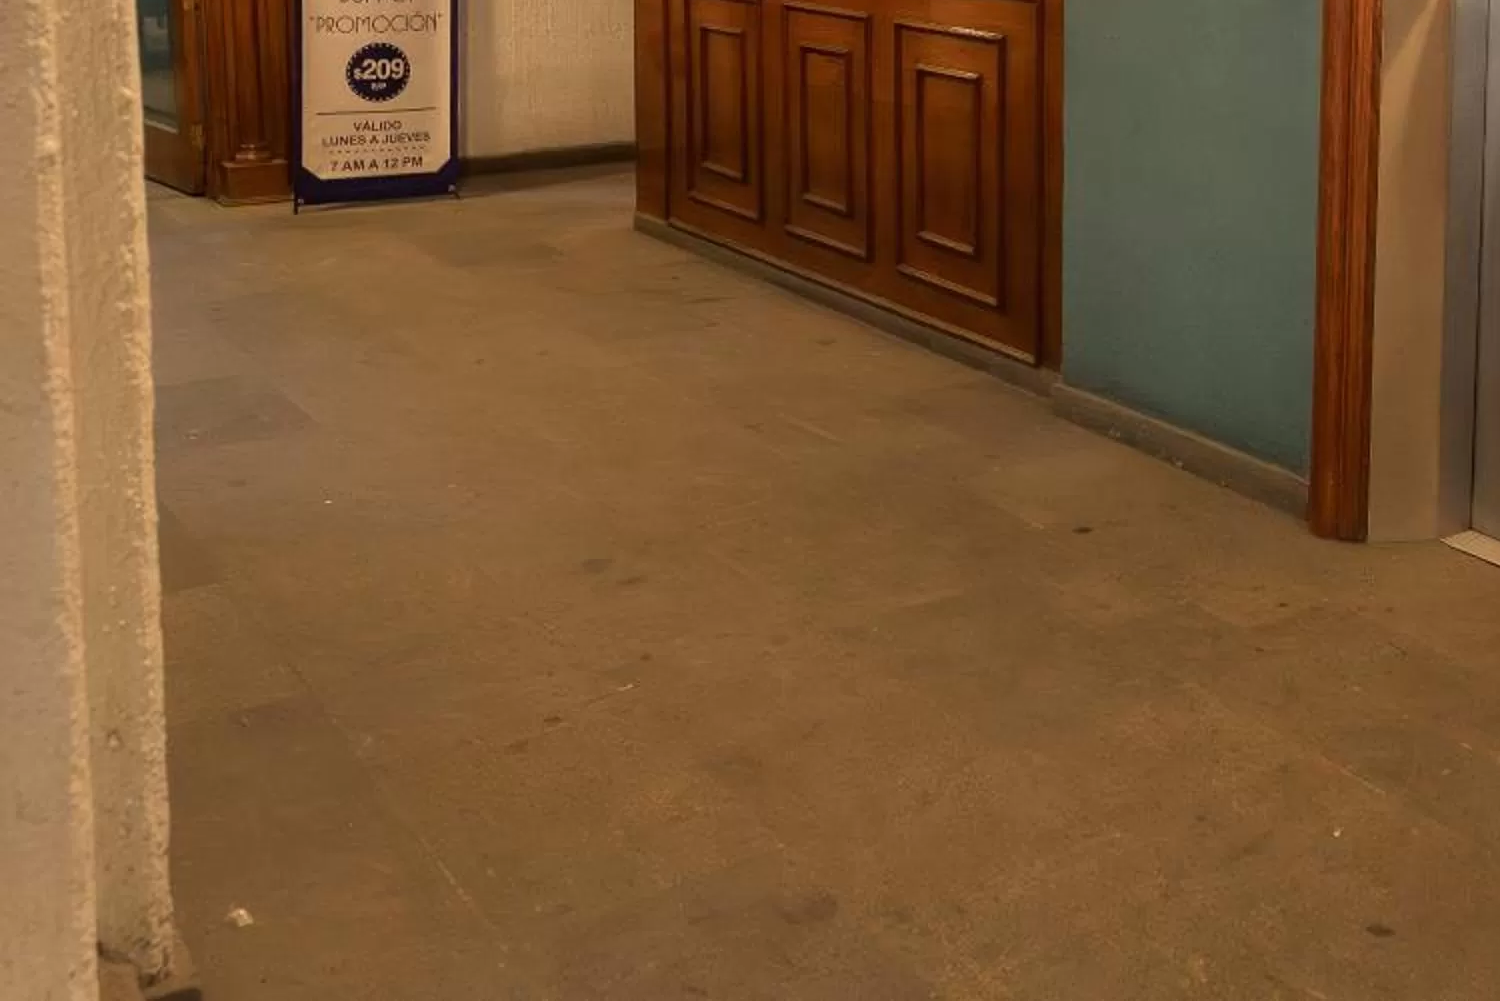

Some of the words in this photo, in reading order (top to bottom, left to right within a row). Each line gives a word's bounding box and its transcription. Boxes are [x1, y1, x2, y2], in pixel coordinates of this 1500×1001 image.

[322, 134, 366, 147] LUNES
[369, 134, 379, 144] A
[381, 131, 431, 144] JUEVES
[331, 160, 338, 171] 7
[342, 159, 365, 171] AM
[368, 159, 379, 170] A
[384, 158, 399, 169] 12
[402, 156, 423, 168] PM
